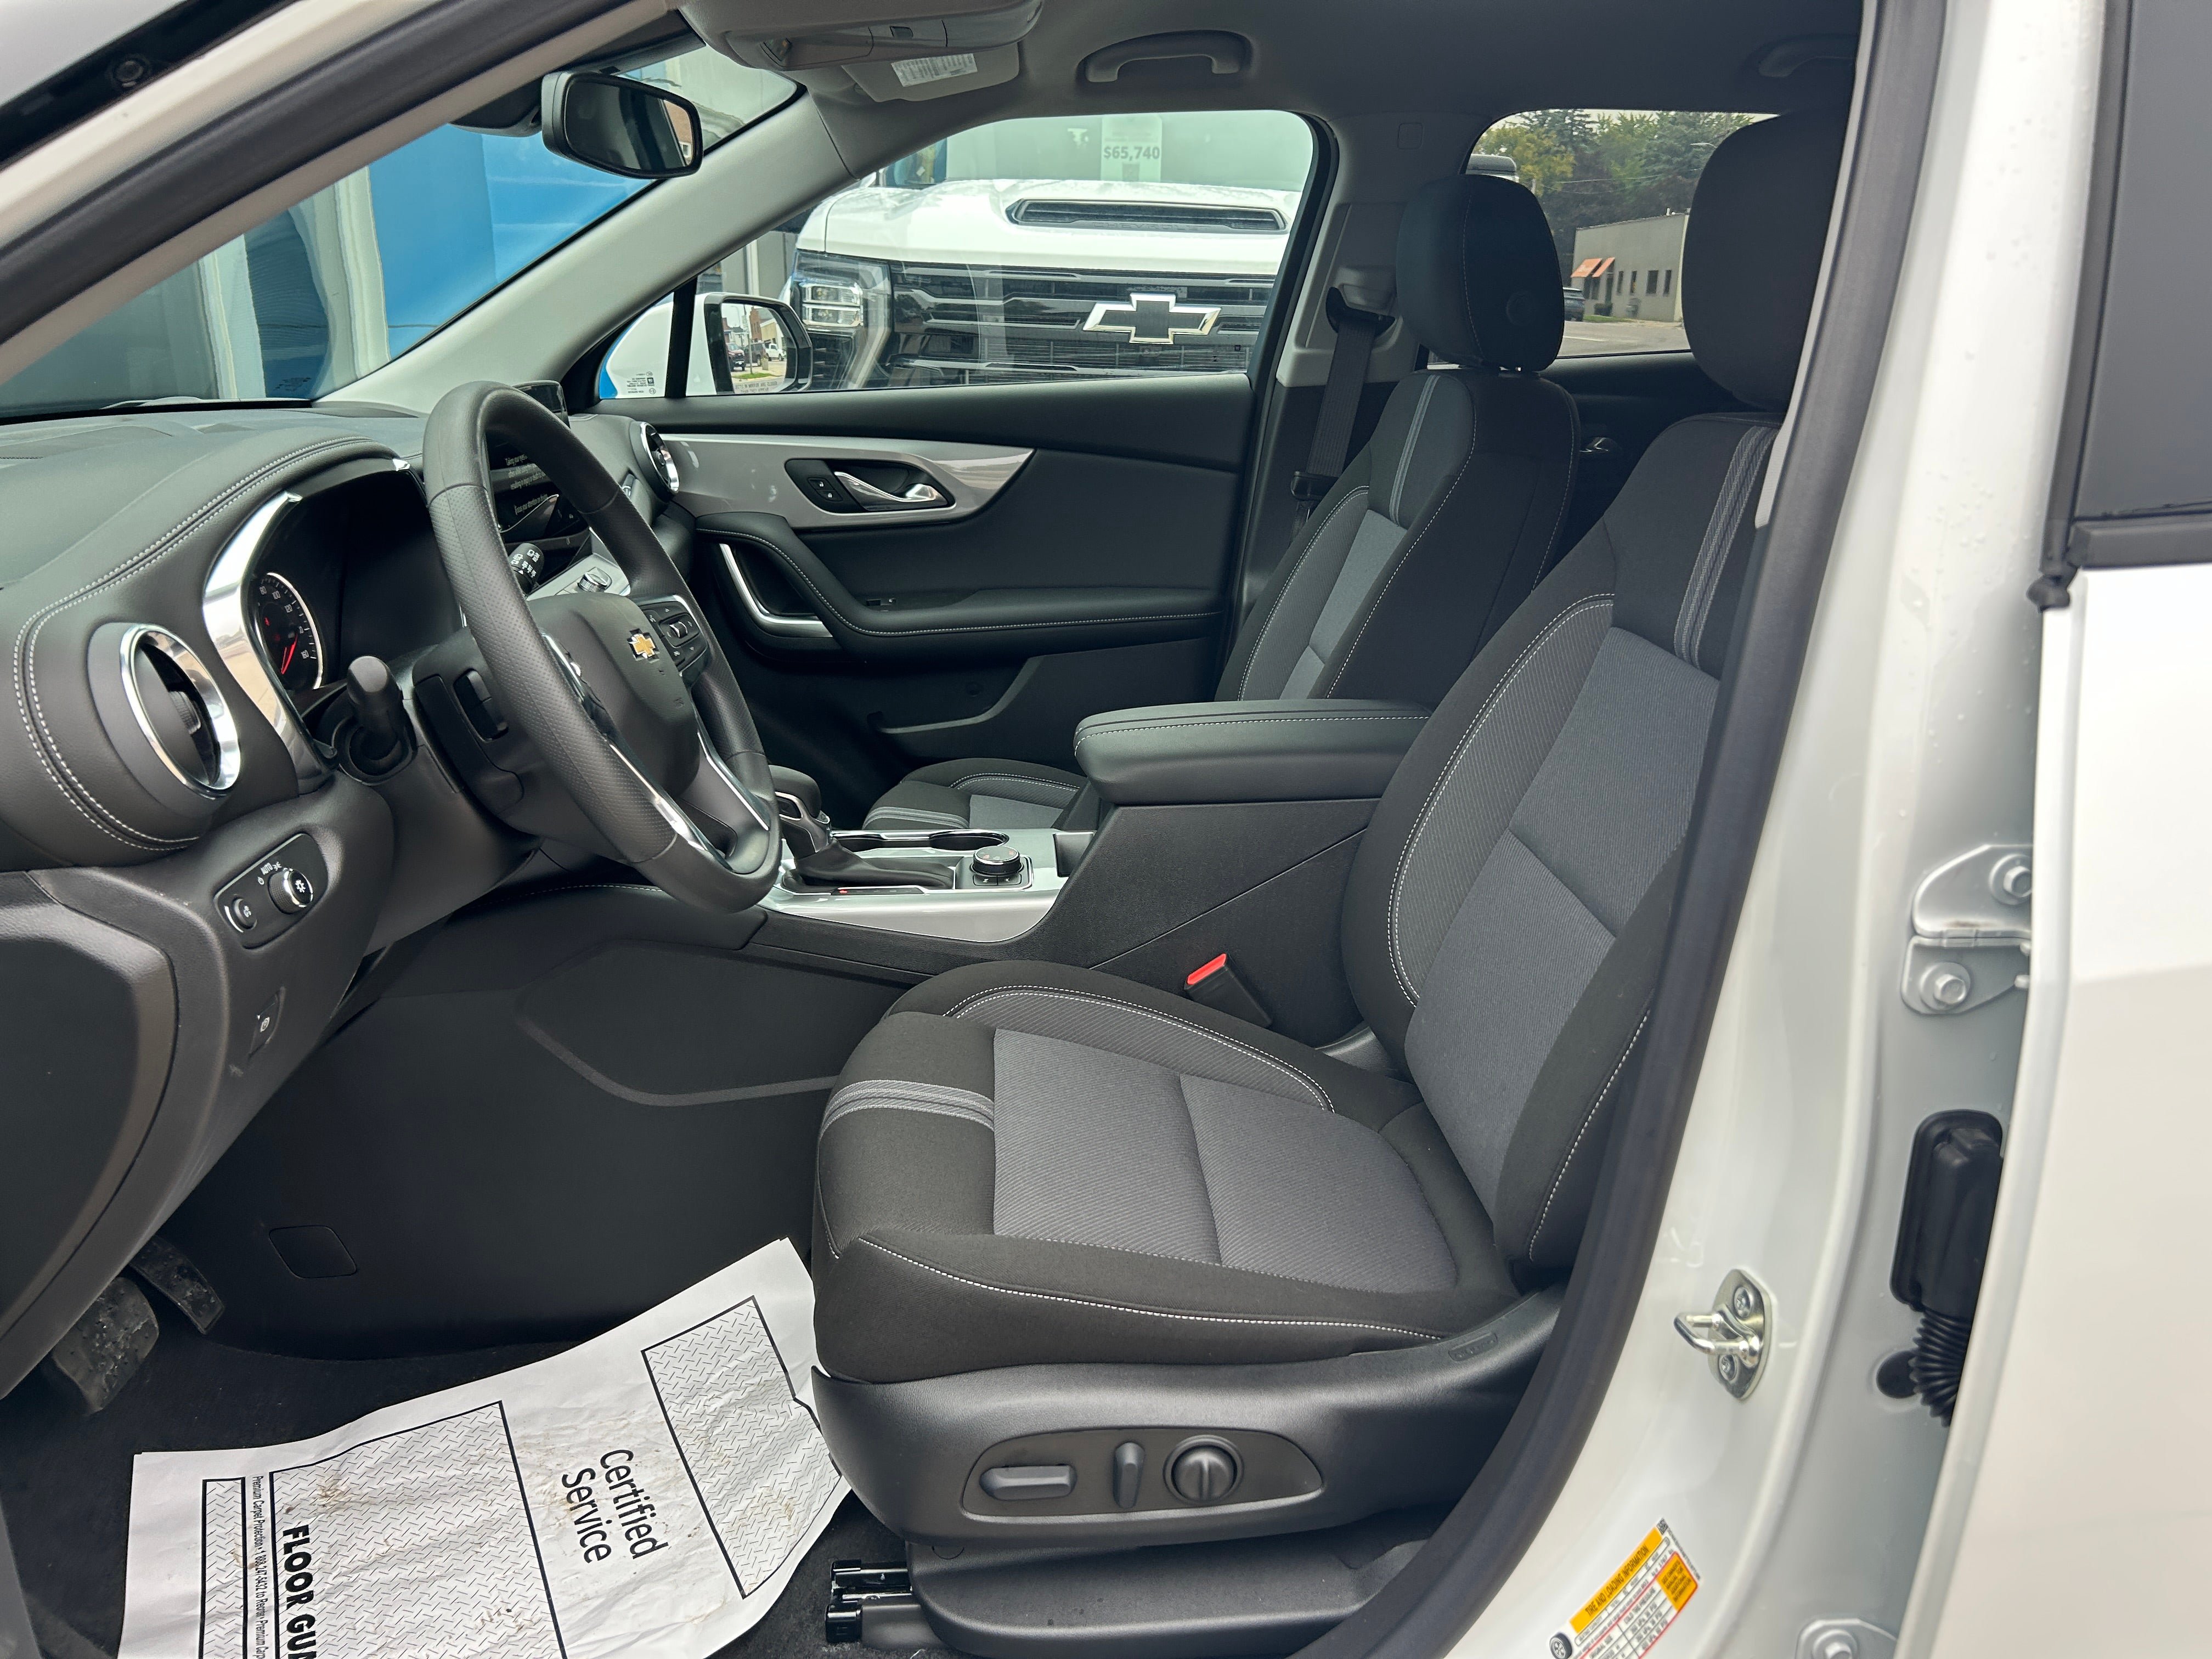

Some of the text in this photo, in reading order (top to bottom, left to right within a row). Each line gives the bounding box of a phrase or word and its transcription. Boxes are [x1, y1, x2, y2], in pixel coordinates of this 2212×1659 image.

[1103, 146, 1160, 161] $65,740
[259, 586, 267, 595] 80
[252, 1475, 264, 1500] Premium
[250, 1500, 265, 1520] Carpet
[561, 1468, 612, 1564] Service
[600, 1449, 669, 1559] Certified
[253, 1520, 266, 1548] Protection
[283, 1524, 314, 1610] FLOOR
[1585, 1601, 1598, 1616] TIRE
[1595, 1592, 1606, 1607] AND
[1605, 1573, 1624, 1599] LOADING
[1622, 1544, 1649, 1577] INFORMATION
[255, 1620, 269, 1646] Premium
[252, 1647, 269, 1659] Carp
